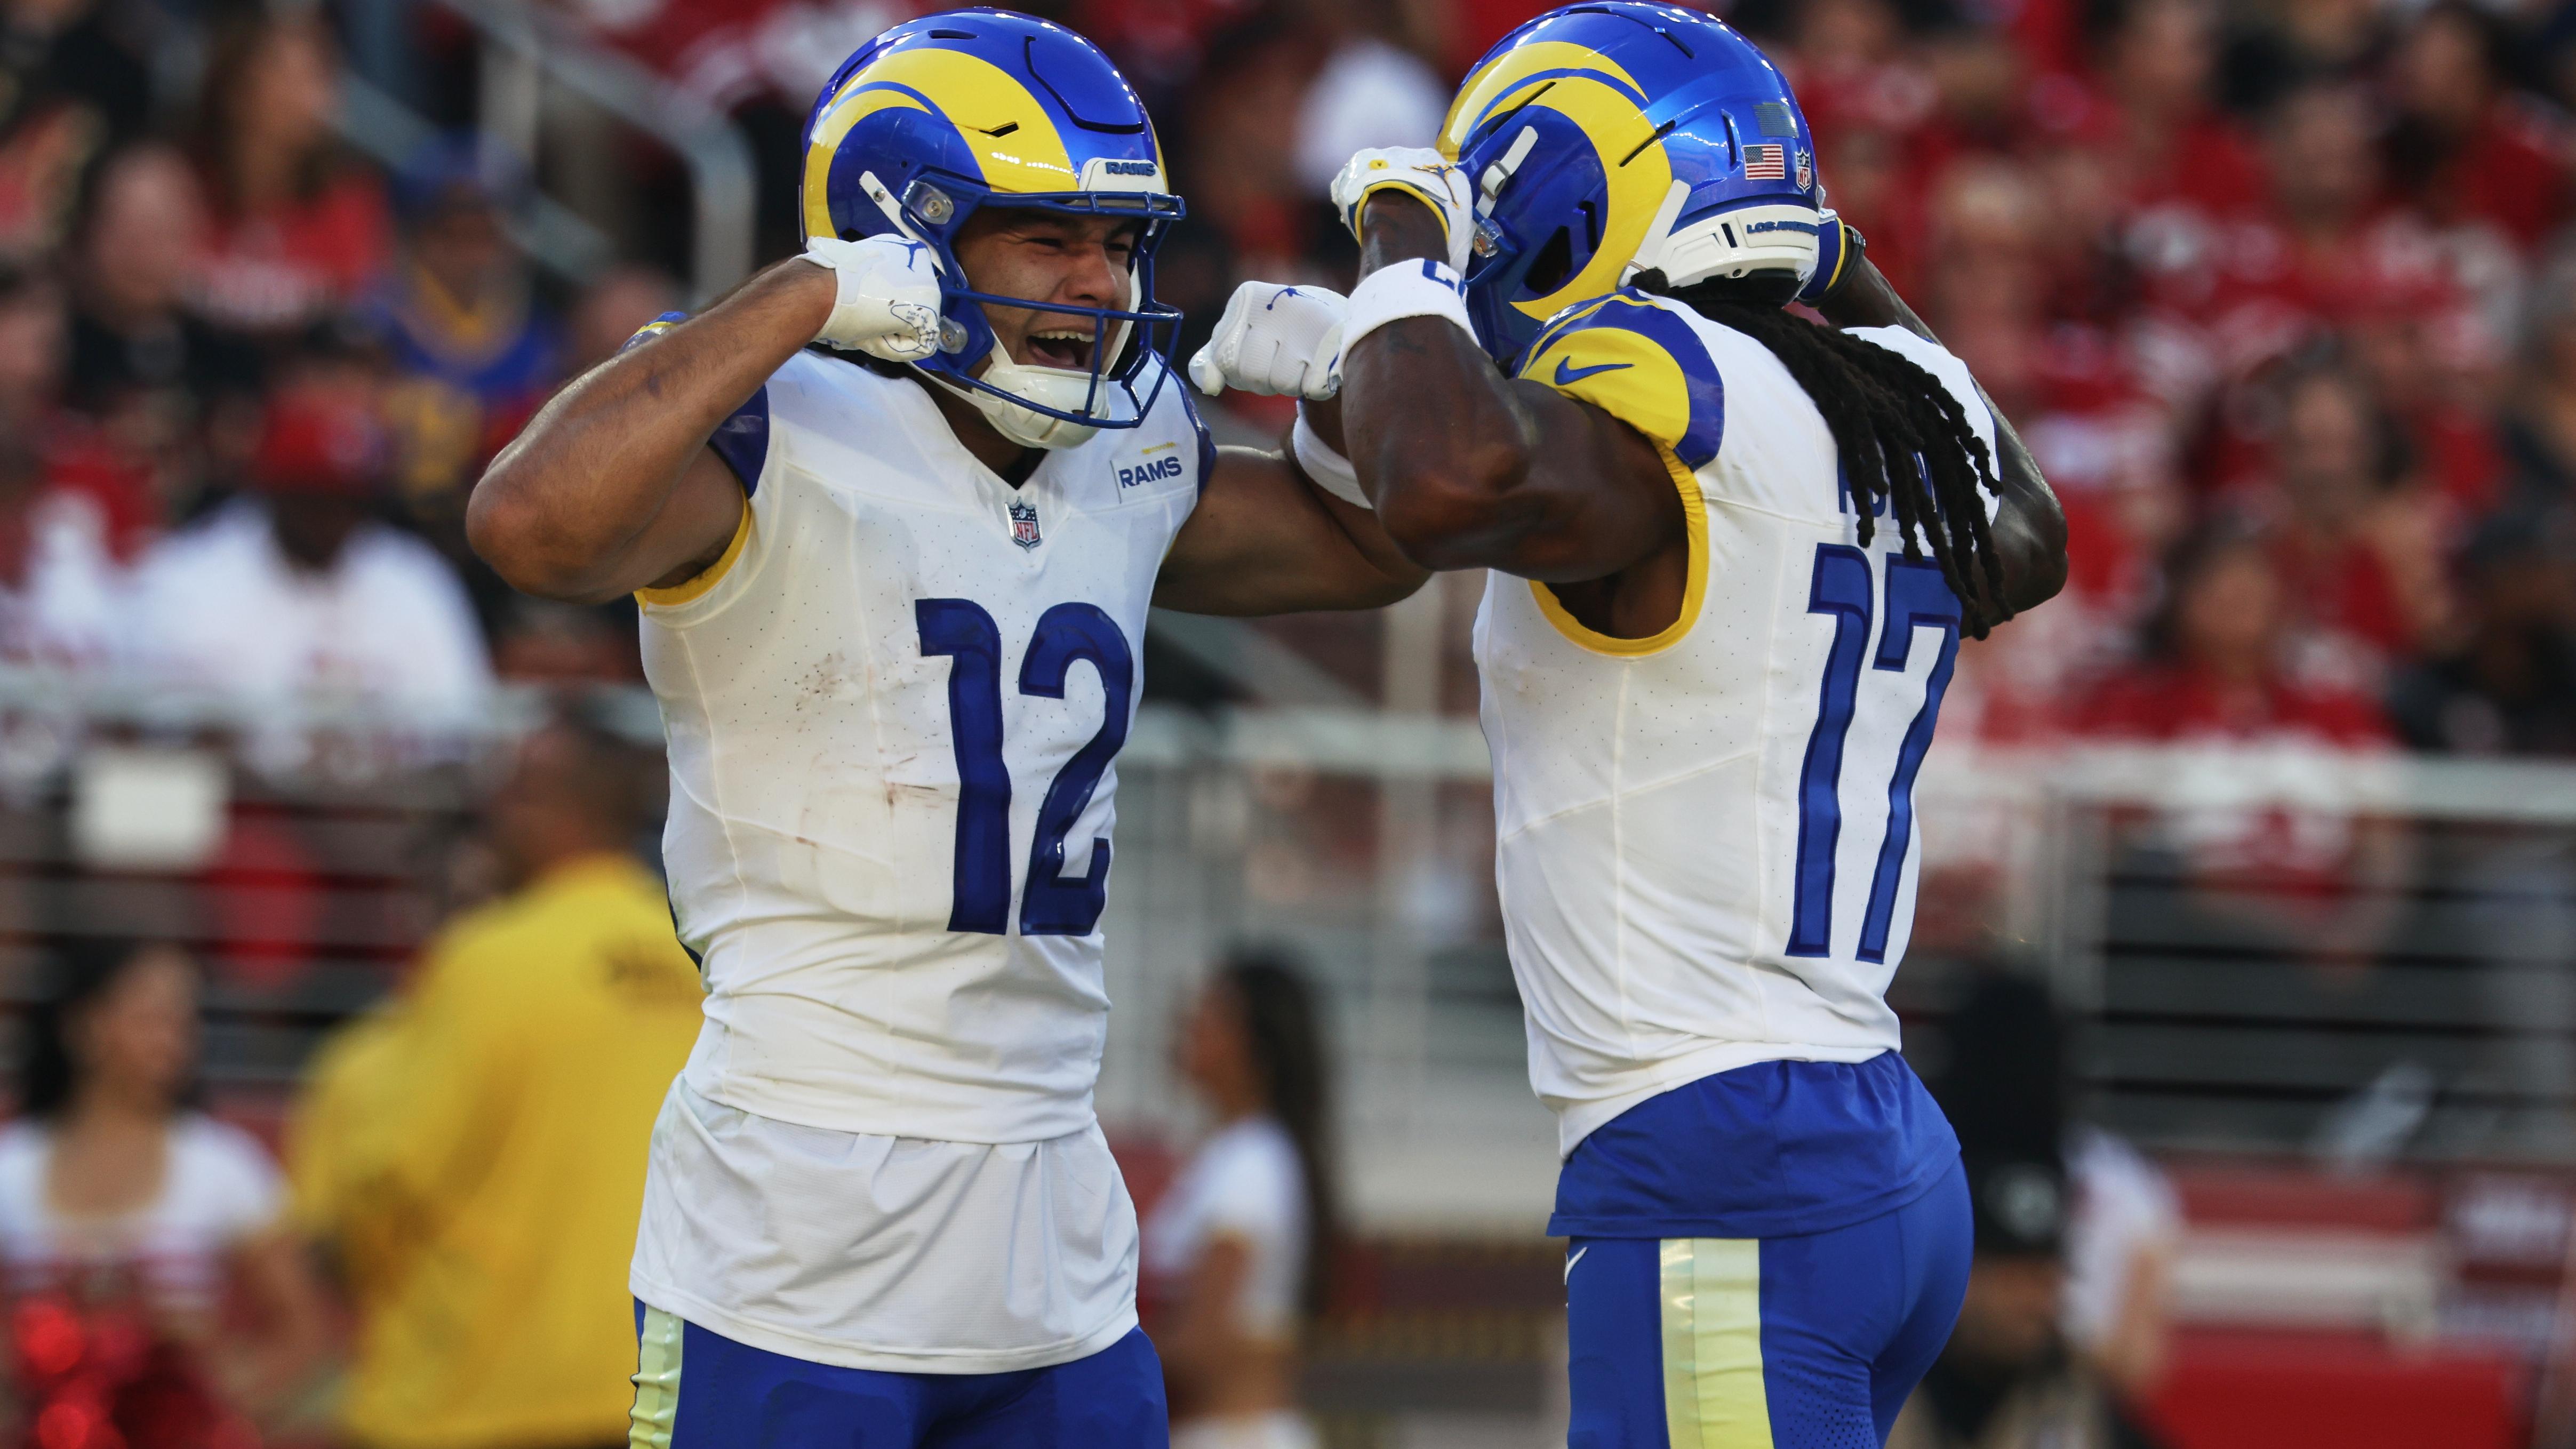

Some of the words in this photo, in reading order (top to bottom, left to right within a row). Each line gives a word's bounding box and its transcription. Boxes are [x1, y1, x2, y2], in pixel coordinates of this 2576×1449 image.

[1105, 162, 1156, 177] RAMS
[1798, 167, 1811, 186] NFL
[1746, 221, 1775, 234] LOS
[1118, 456, 1182, 489] RAMS
[1014, 522, 1038, 542] NFL
[1785, 542, 1963, 965] 17
[915, 598, 1133, 936] 12
